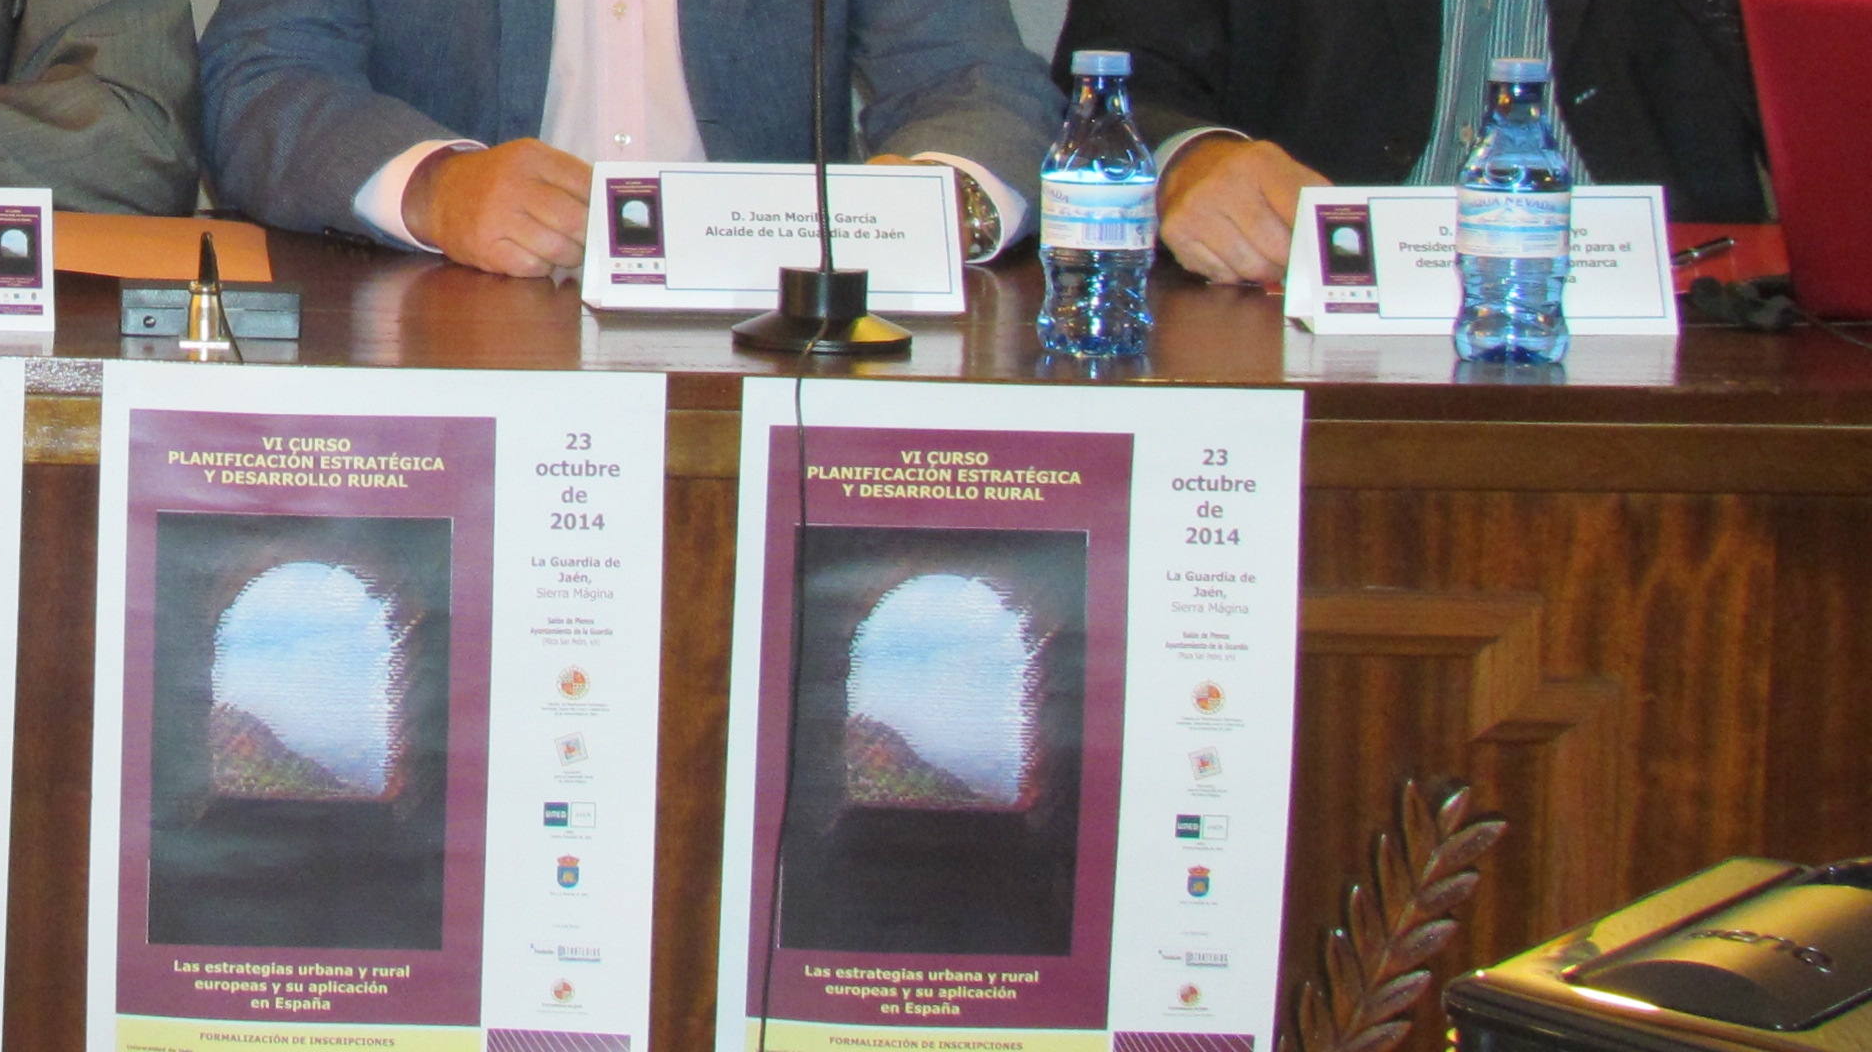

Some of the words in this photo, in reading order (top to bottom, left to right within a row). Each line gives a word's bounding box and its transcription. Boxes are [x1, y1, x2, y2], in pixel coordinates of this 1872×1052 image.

[731, 211, 745, 221] D.
[749, 212, 781, 222] Juan
[834, 212, 877, 224] García
[705, 226, 753, 236] Alcalde
[758, 227, 774, 237] de
[778, 227, 793, 237] La
[798, 228, 849, 238] Guadia
[854, 229, 870, 239] de
[875, 229, 905, 239] Jaén
[1439, 226, 1453, 236] D.
[1399, 242, 1456, 252] Presiden
[1586, 243, 1614, 254] para
[1619, 242, 1631, 251] el
[1568, 259, 1617, 268] omarca
[262, 436, 283, 450] VI
[288, 438, 350, 452] CURSO
[566, 433, 592, 450] 23
[168, 450, 314, 469] PLANIFICACIÓN
[320, 452, 444, 470] ESTRATÉGICA
[901, 450, 921, 464] VI
[927, 451, 988, 465] CURSO
[1203, 449, 1228, 466] 23
[536, 460, 621, 477] octubre
[807, 466, 952, 482] PLANIFICACIÓN
[958, 466, 1082, 484] ESTRATÉGICA
[204, 470, 216, 483] Y
[222, 470, 342, 486] DESARROLLO
[348, 473, 408, 488] RURAL
[1172, 475, 1256, 493] octubre
[561, 486, 588, 504] de
[842, 484, 854, 496] Y
[860, 484, 978, 499] DESARROLLO
[984, 487, 1044, 500] RURAL
[1197, 501, 1224, 518] de
[550, 513, 605, 530] 2014
[1185, 527, 1240, 545] 2014
[531, 556, 546, 567] La
[550, 557, 600, 568] Guardia
[605, 557, 621, 568] de
[558, 572, 592, 585] Jaén,
[173, 960, 200, 973] Las
[204, 961, 293, 977] estrategias
[298, 963, 353, 977] urbana
[359, 967, 367, 978] y
[372, 965, 410, 977] rural
[805, 965, 830, 978] Las
[835, 968, 923, 981] estrategias
[928, 969, 983, 982] urbana
[988, 972, 997, 984] y
[1001, 970, 1039, 983] rural
[194, 978, 266, 993] europeas
[272, 983, 281, 994] y
[286, 982, 303, 993] su
[308, 980, 388, 995] aplicación
[825, 984, 896, 998] europeas
[902, 988, 911, 1000] y
[915, 987, 933, 998] su
[938, 986, 1017, 999] aplicación
[251, 998, 269, 1009] en
[275, 997, 331, 1011] España
[881, 1003, 899, 1014] en
[905, 1001, 960, 1016] España
